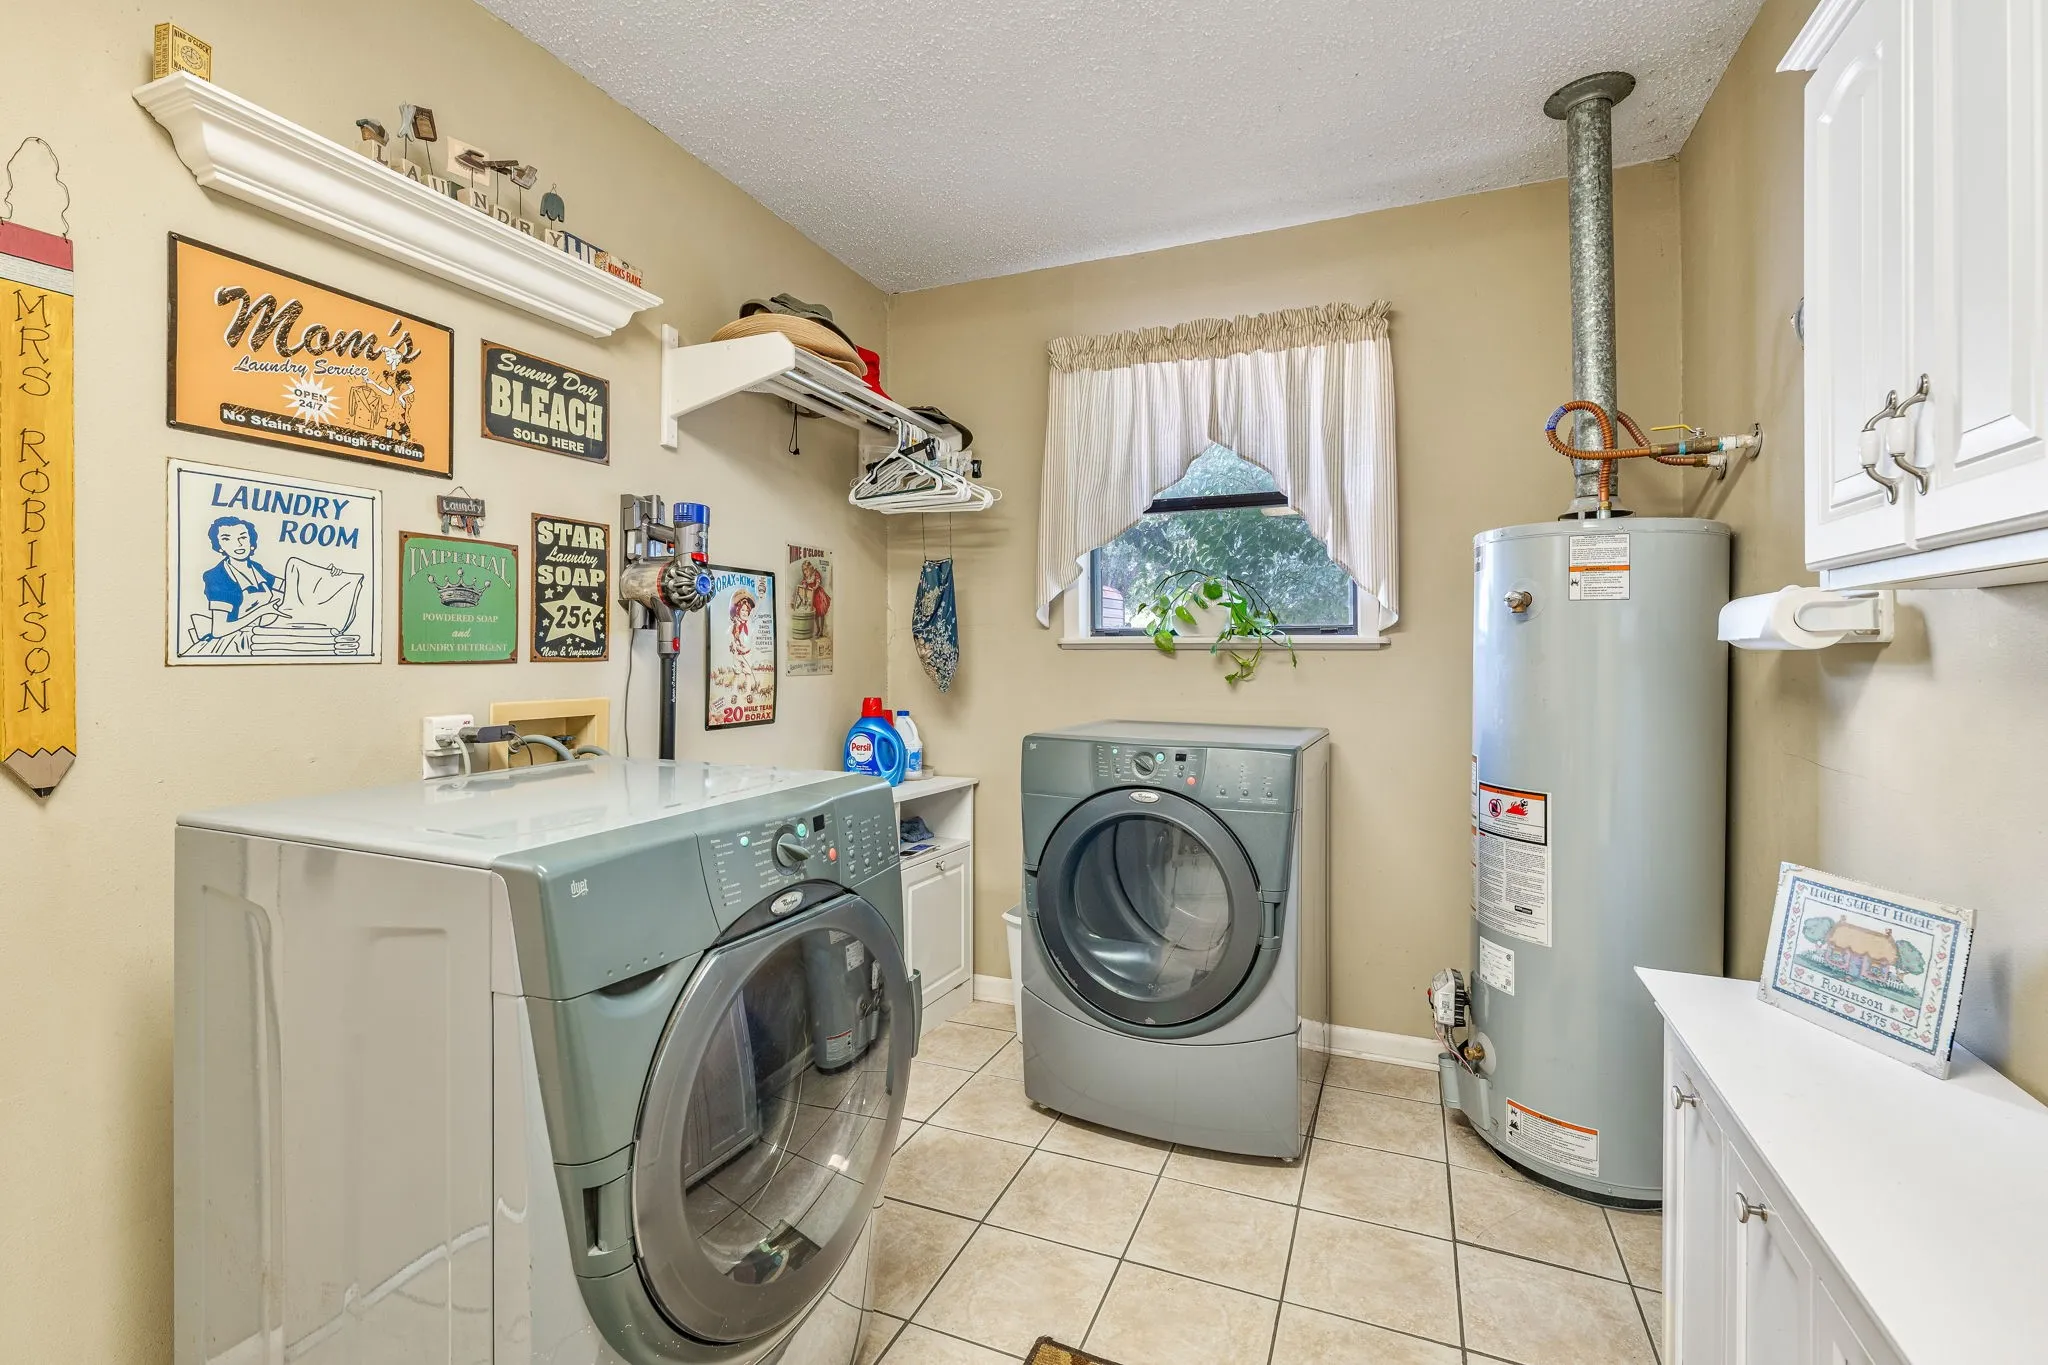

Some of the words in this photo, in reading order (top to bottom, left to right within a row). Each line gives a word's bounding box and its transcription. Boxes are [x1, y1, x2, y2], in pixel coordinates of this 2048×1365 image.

[173, 29, 187, 40] NINE
[214, 285, 421, 364] Mom's
[13, 289, 51, 396] MRS
[232, 354, 308, 378] Laundry
[313, 358, 369, 377] Service
[497, 353, 557, 389] Sunny
[562, 372, 599, 402] Day
[294, 388, 328, 402] OPEN
[299, 399, 324, 412] 24/7
[490, 373, 603, 442] BLEACH
[222, 409, 246, 424] No
[250, 414, 292, 433] Stain
[297, 423, 323, 438] Too
[327, 429, 369, 450] Tough
[371, 440, 393, 453] For
[394, 444, 424, 459] Mom
[513, 427, 548, 445] SOLD
[551, 436, 585, 454] HERE
[211, 483, 350, 521] LAUNDRY
[442, 499, 482, 514] Laundry
[279, 520, 359, 550] ROOM
[537, 520, 605, 550] STAR
[545, 546, 599, 569] Laundry
[803, 547, 824, 558] O'CLOCK
[17, 428, 51, 714] ROBINSON
[408, 546, 512, 590] IMPERIAL
[537, 565, 606, 588] SOAP
[422, 612, 475, 623] POWDERED
[476, 614, 498, 624] SOAP
[555, 604, 592, 629] 25¢
[451, 627, 472, 638] and
[411, 642, 455, 652] LAUNDRY
[456, 642, 508, 652] DETERGENT
[540, 646, 558, 657] New
[560, 646, 566, 657] &
[568, 645, 603, 658] Improved!
[724, 706, 744, 724] 20
[745, 712, 771, 721] BORAX
[851, 742, 872, 752] Persil
[1810, 886, 1845, 905] HOME
[1846, 897, 1891, 917] SWEET
[1893, 910, 1935, 931] HOME
[1820, 976, 1884, 1011] Robinson
[1811, 991, 1839, 1008] EST
[1859, 1010, 1887, 1029] 1975
